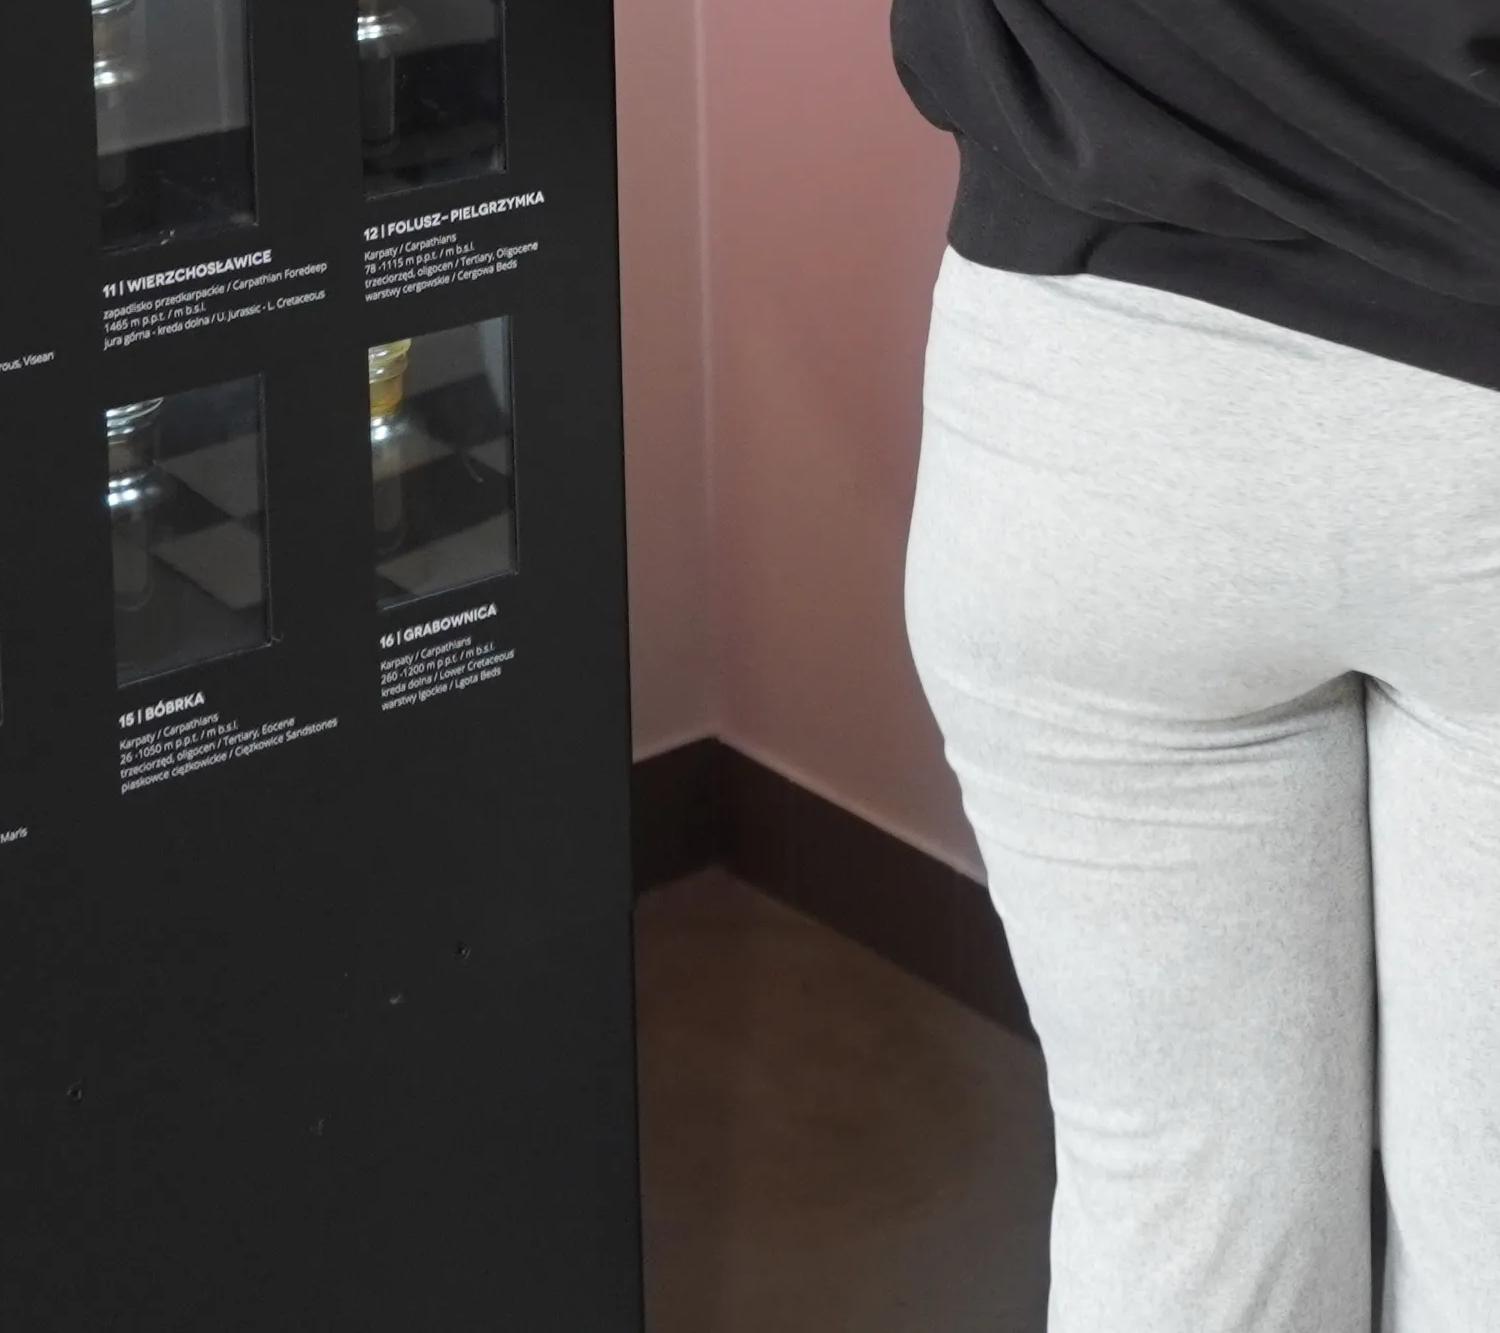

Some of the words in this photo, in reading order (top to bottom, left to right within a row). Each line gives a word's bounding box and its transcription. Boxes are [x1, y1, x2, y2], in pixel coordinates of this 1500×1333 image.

[363, 226, 379, 241] 12
[102, 283, 116, 298] 11
[126, 249, 272, 293] WIERZCHOSŁAWICE
[379, 634, 395, 649] 16
[403, 604, 497, 642] GRABOWNICA
[118, 712, 135, 728] 15
[145, 691, 205, 721] BÓBRKA
